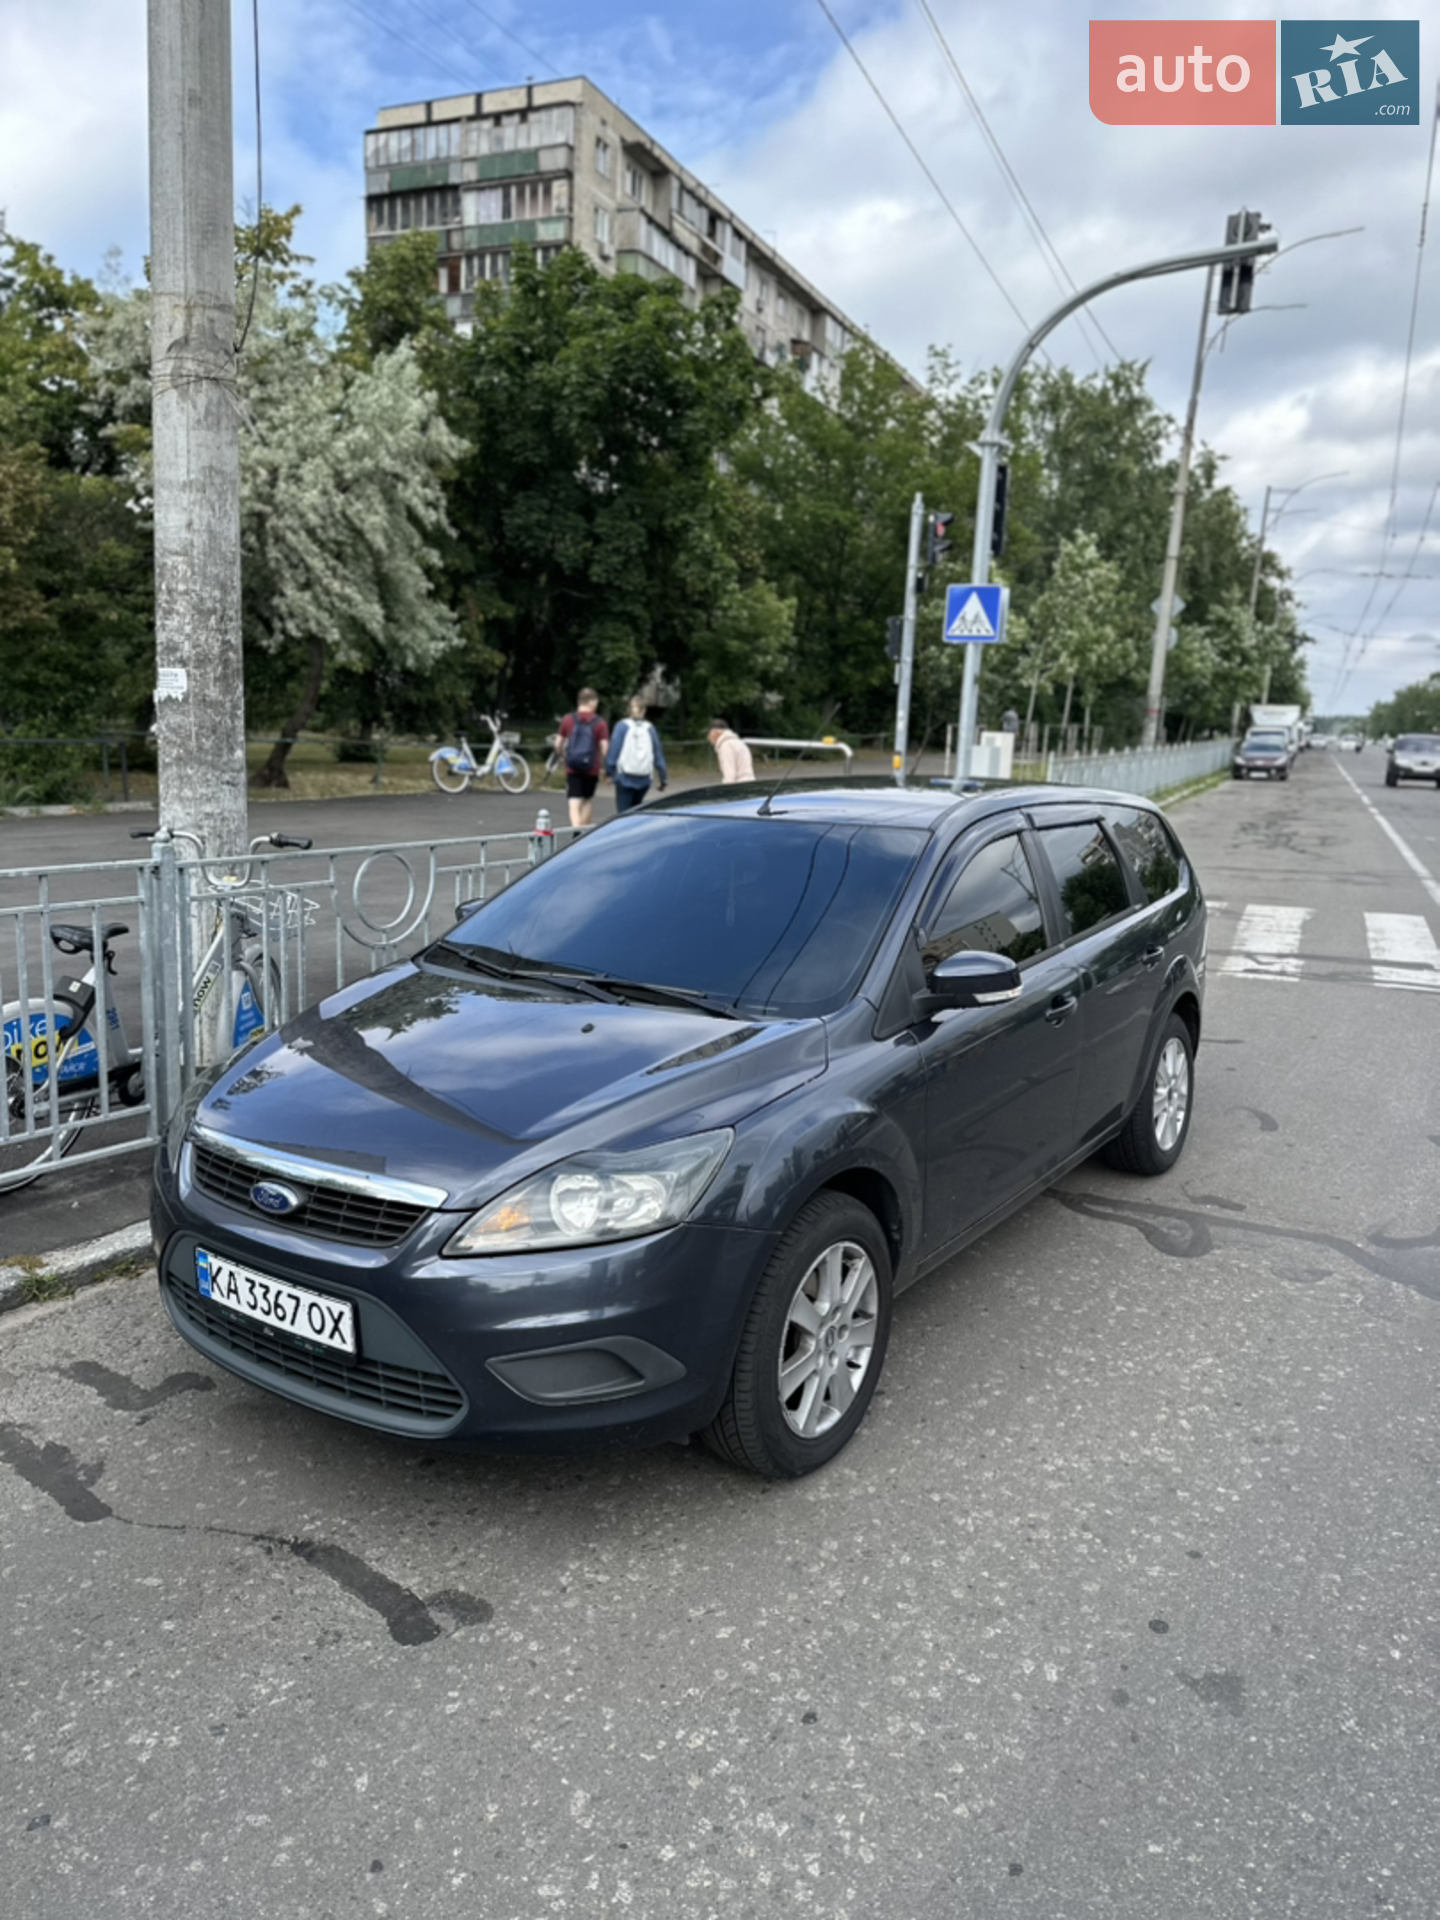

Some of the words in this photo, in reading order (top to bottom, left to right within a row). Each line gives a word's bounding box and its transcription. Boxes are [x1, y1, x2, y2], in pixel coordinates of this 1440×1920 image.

[257, 1187, 284, 1208] Ford
[209, 1262, 241, 1305] KA
[244, 1276, 301, 1327] 3367
[307, 1301, 347, 1345] OX
